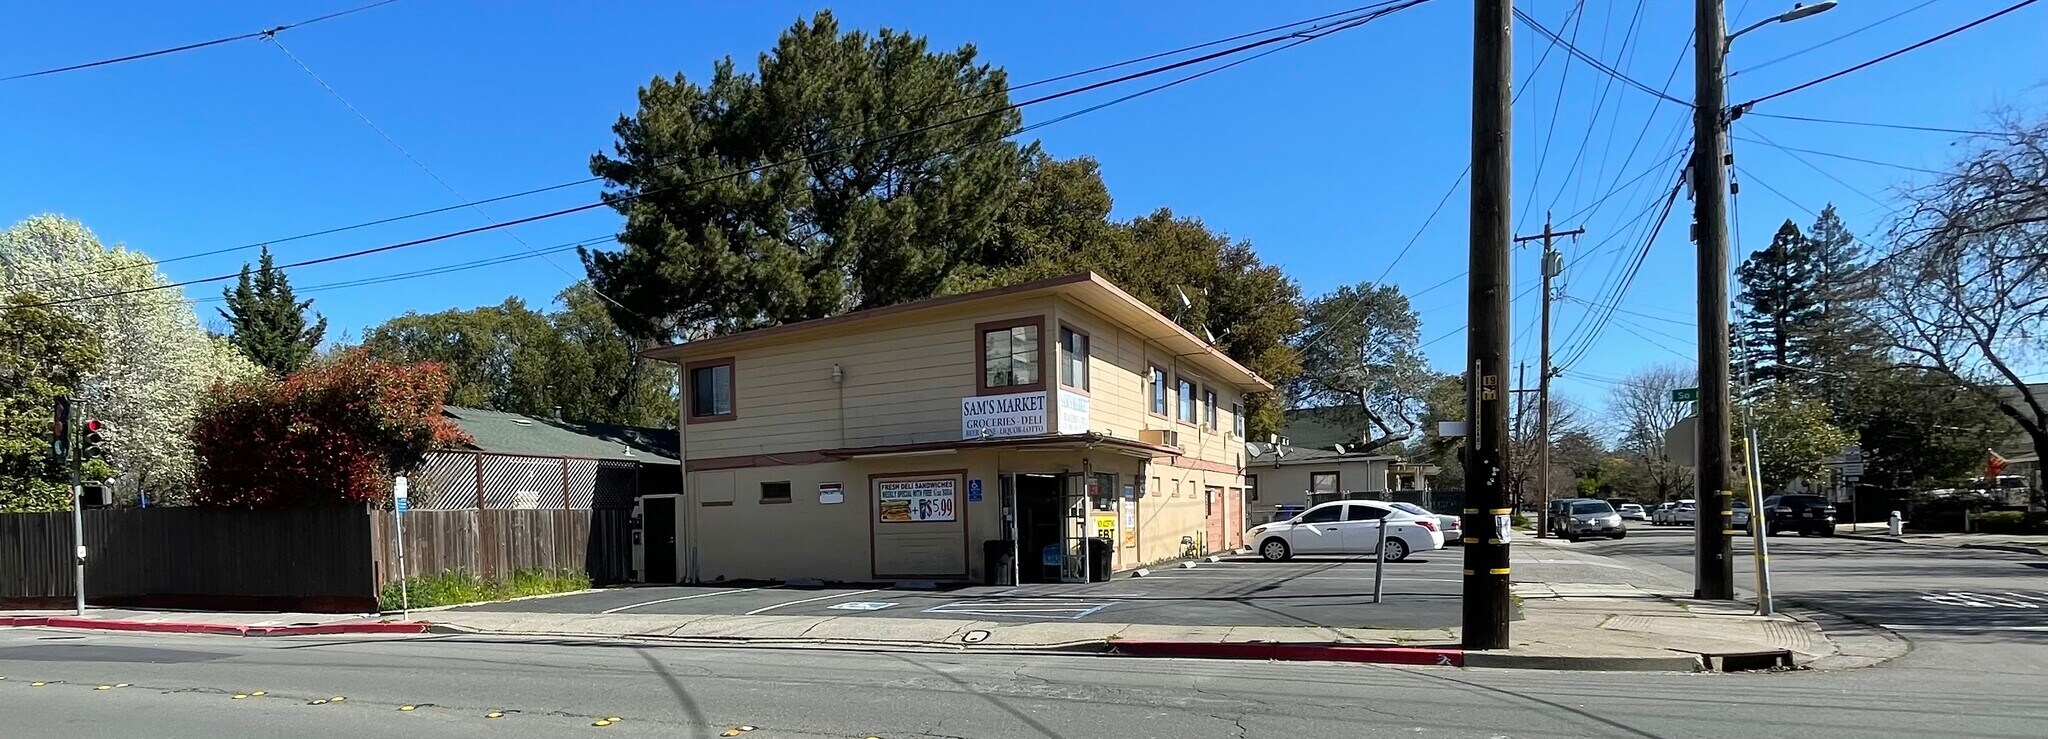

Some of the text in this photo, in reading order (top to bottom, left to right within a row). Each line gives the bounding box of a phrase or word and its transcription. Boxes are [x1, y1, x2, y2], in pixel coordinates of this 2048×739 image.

[1677, 391, 1691, 400] So
[964, 396, 1045, 416] SAM'S MARKET
[966, 417, 1016, 429] GROCERIES
[1021, 415, 1042, 425] DELI
[881, 481, 953, 491] FRESH DELI SANDWICHES
[925, 498, 953, 518] $5.99
